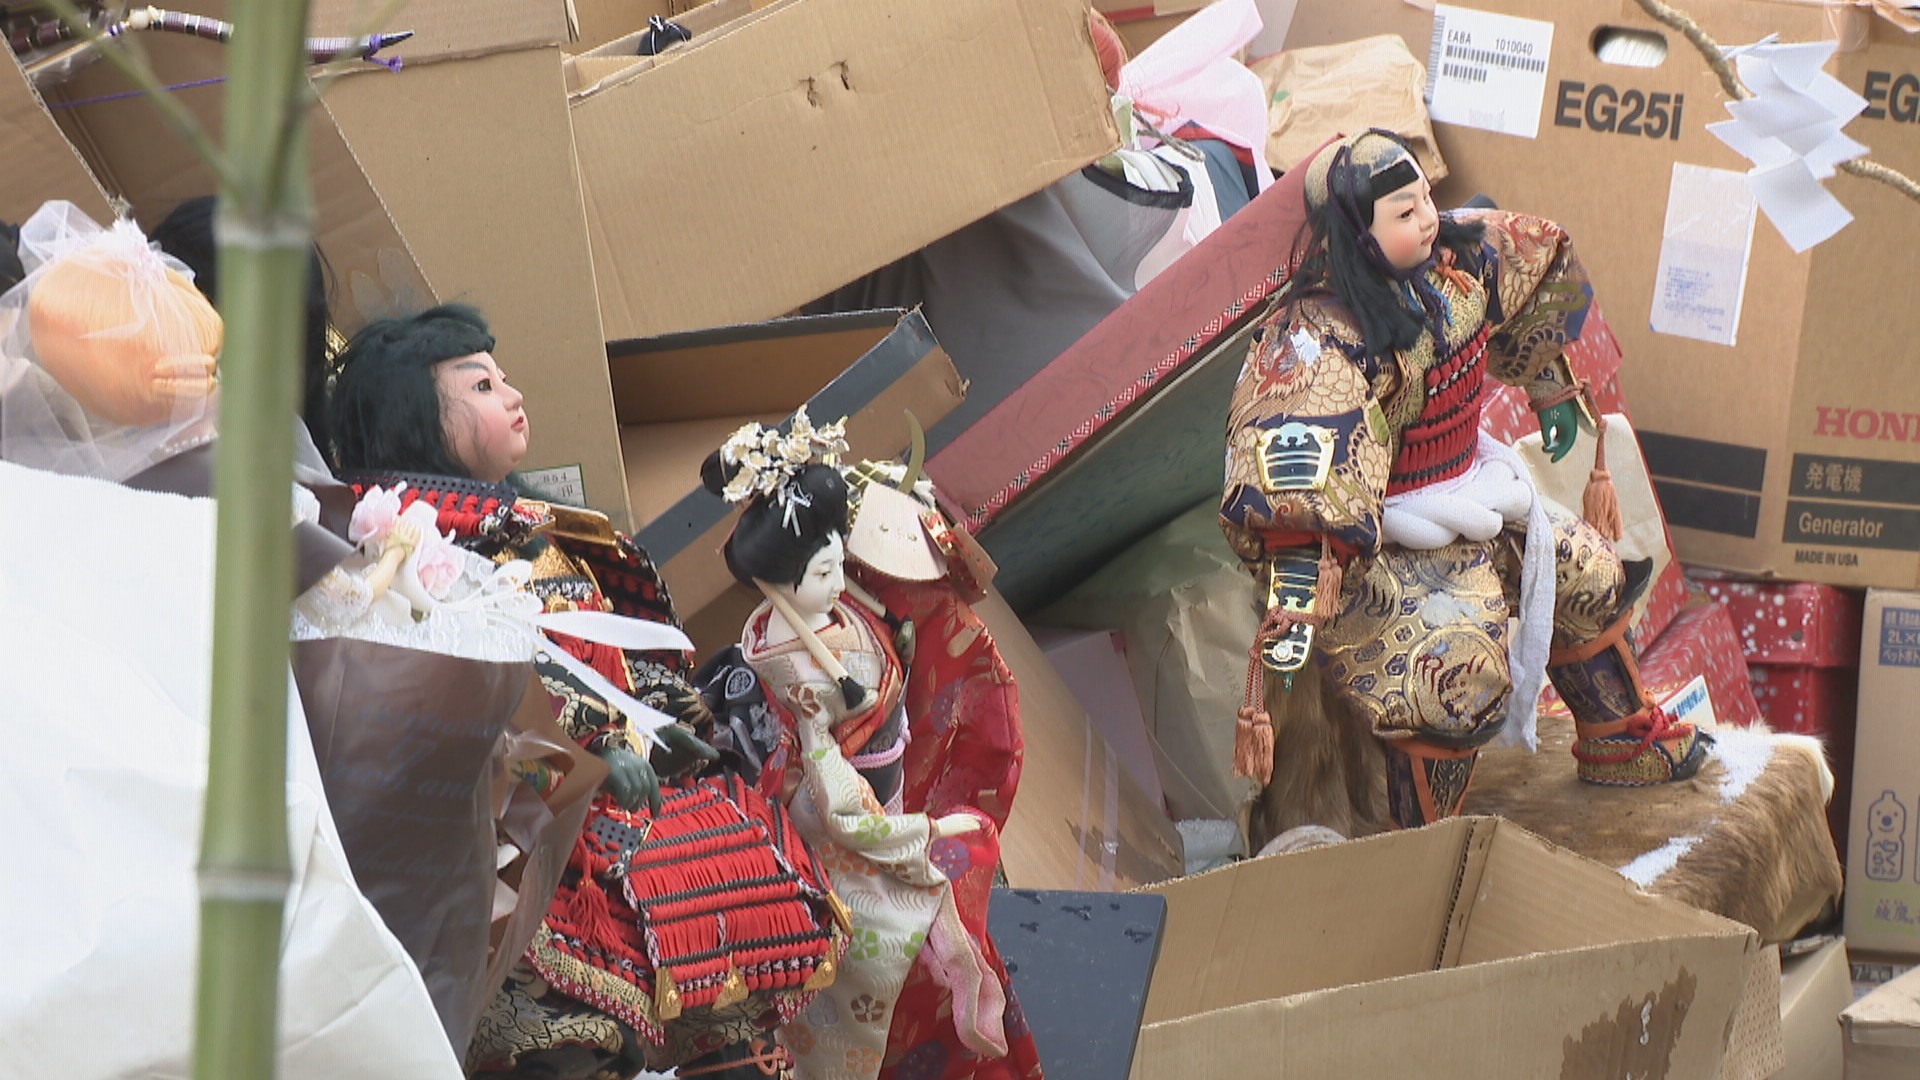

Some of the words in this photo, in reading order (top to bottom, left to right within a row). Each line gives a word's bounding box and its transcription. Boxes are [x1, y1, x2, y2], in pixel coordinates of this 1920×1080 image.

[1447, 29, 1471, 44] EABA
[1554, 79, 1684, 141] EG25i
[1860, 71, 1920, 124] EG
[1804, 462, 1863, 493] 発電機
[1799, 511, 1884, 538] Generator
[1795, 550, 1824, 564] MADE
[1825, 553, 1836, 565] IN
[1838, 553, 1858, 567] USA
